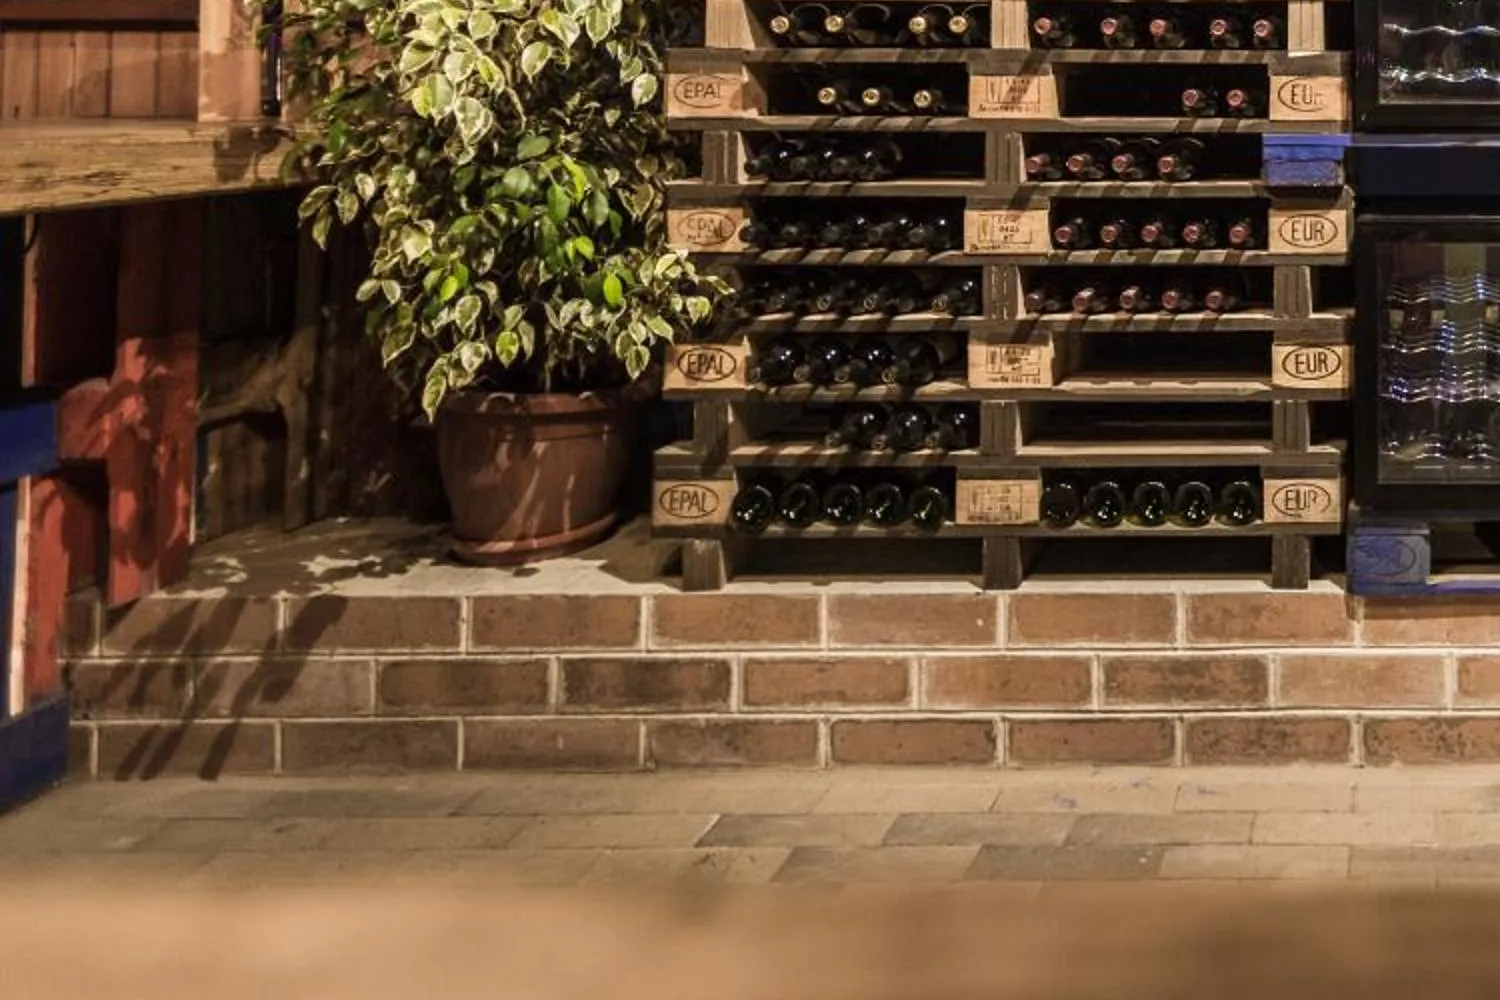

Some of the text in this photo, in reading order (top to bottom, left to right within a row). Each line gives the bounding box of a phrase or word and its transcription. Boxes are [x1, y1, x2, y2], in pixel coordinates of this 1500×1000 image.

[1291, 220, 1325, 241] EUR
[687, 353, 726, 376] EPAL
[1294, 353, 1329, 374] EUR
[668, 490, 708, 513] EPAL
